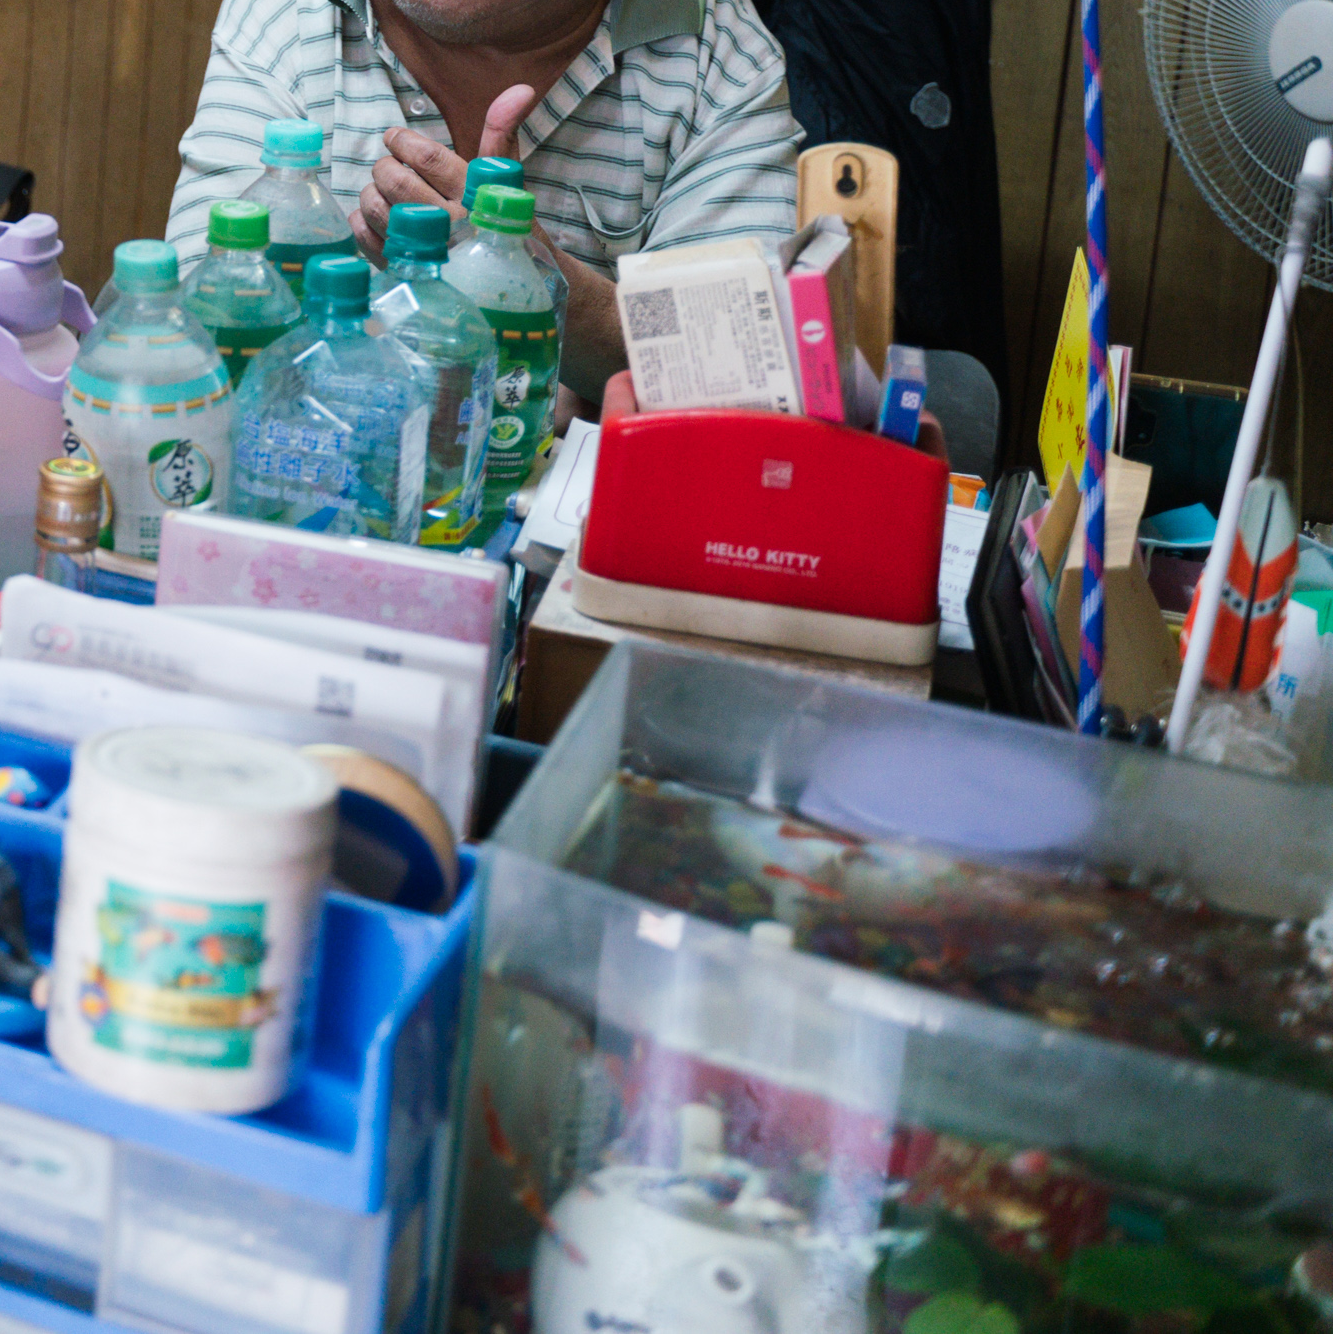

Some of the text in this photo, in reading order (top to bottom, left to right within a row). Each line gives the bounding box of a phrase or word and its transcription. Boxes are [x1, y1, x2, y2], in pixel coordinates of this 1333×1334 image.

[503, 366, 526, 411] 原萃
[162, 439, 196, 507] 原萃
[705, 541, 821, 569] HELLO KITTY
